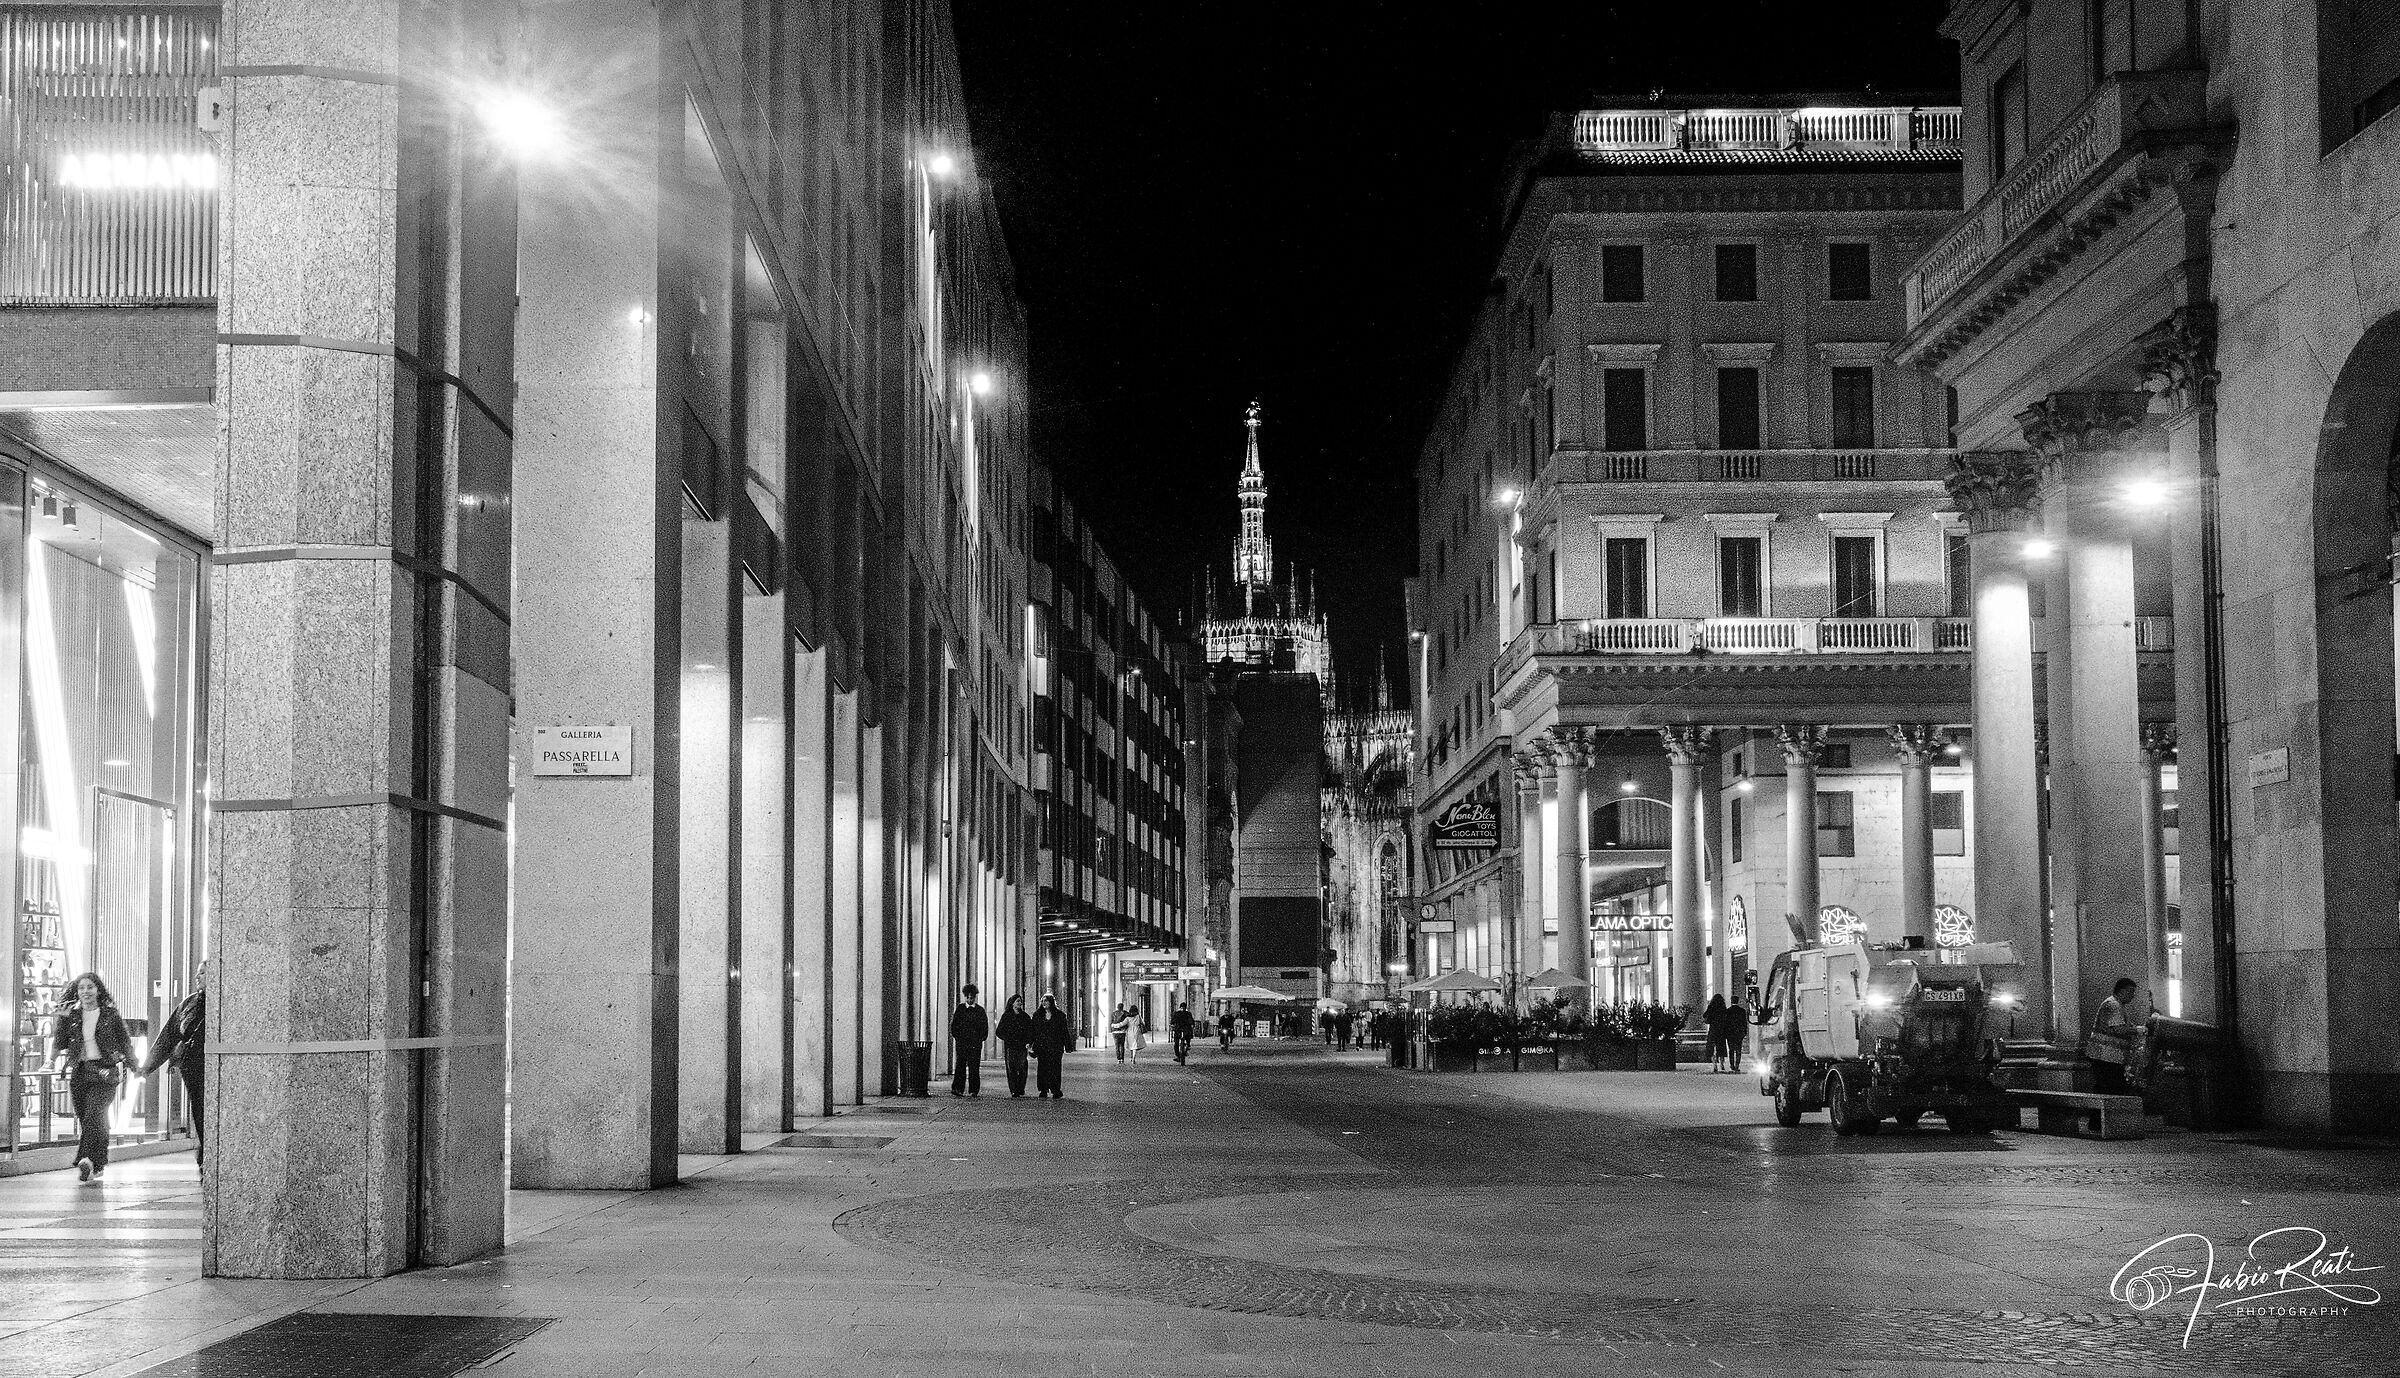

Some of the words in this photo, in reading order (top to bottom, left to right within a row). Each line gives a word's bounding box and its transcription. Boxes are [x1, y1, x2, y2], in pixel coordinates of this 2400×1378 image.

[59, 153, 215, 188] ARMANI
[560, 731, 602, 739] GALLERIA
[543, 751, 620, 762] PASSARELLA
[1630, 916, 1674, 930] OPTIC
[1925, 991, 1936, 1001] GS
